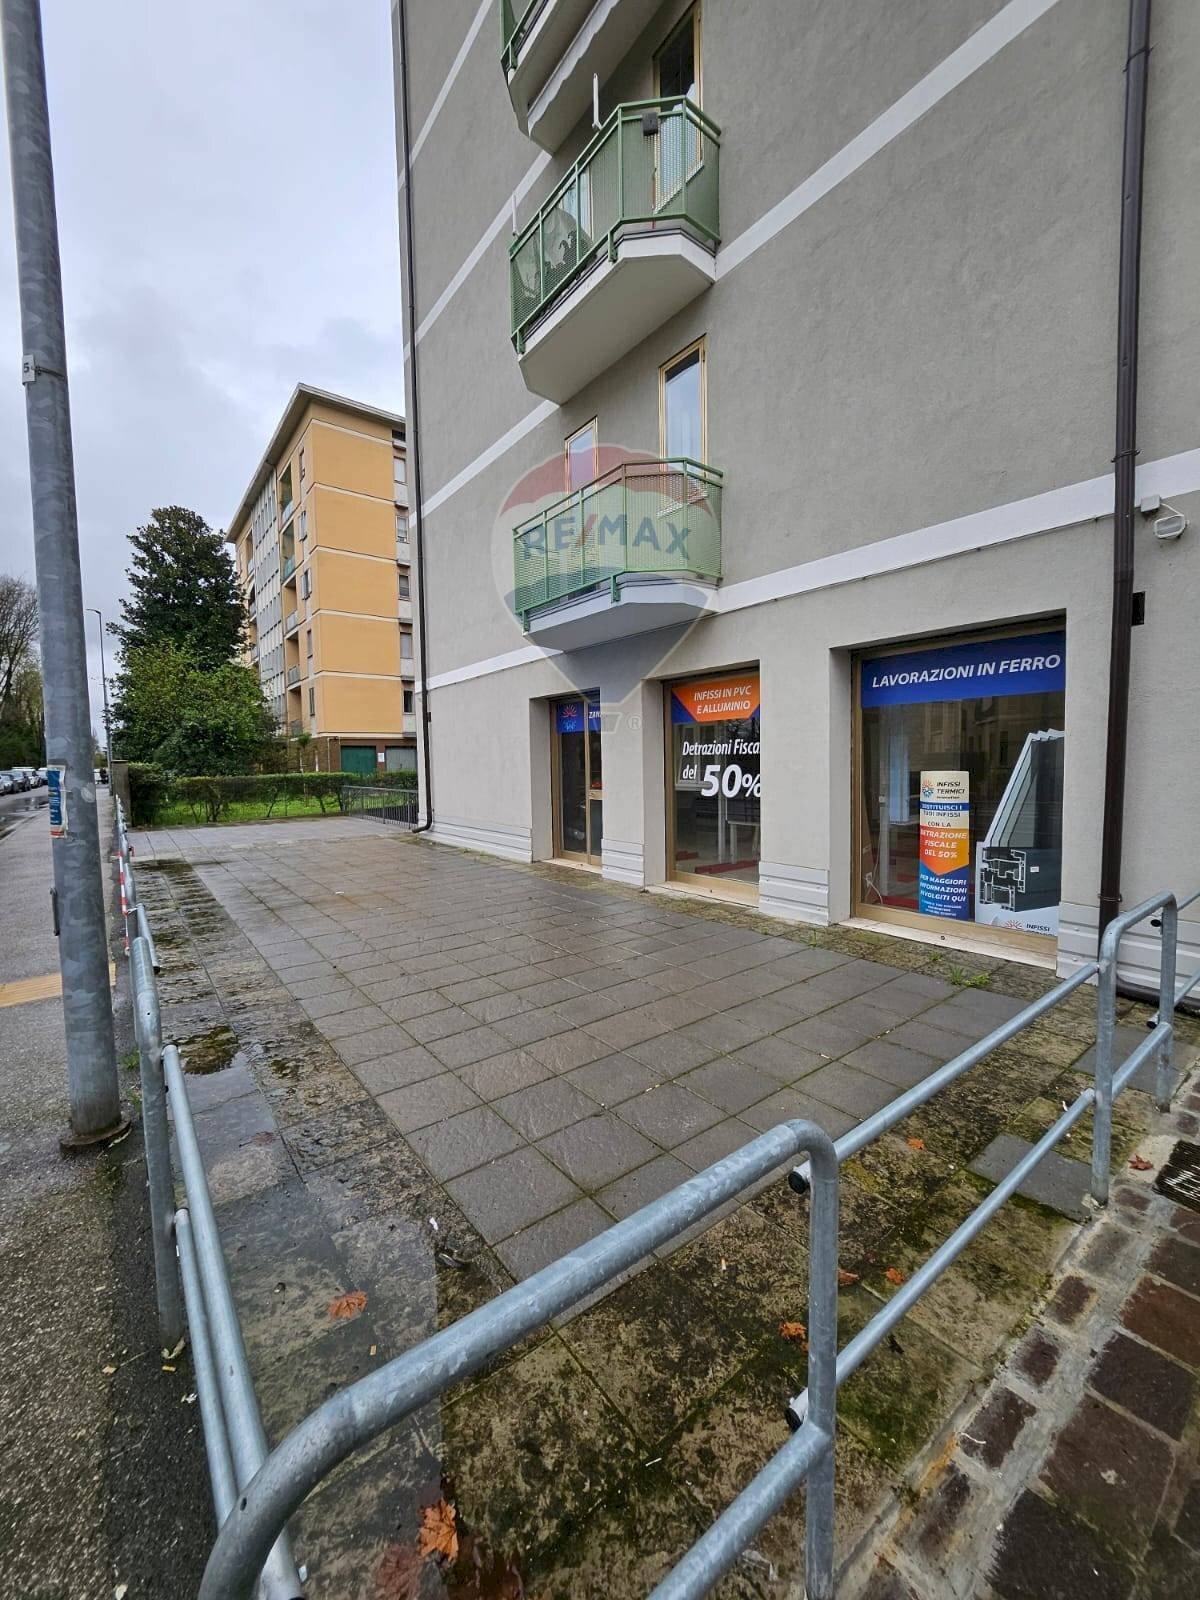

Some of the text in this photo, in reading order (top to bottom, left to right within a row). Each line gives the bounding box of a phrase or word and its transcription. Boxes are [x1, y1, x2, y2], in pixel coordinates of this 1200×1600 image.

[872, 654, 1061, 688] LAVORAZIONI IN FERRO
[694, 685, 752, 701] INFISSI IN PVC
[697, 700, 751, 714] E ALLUMINIO
[682, 739, 760, 756] Detrazioni Fisca
[682, 763, 761, 798] del 50%
[924, 840, 958, 848] FISCALE
[929, 876, 966, 886] MAGGIORI
[1026, 923, 1050, 931] INFISSI
